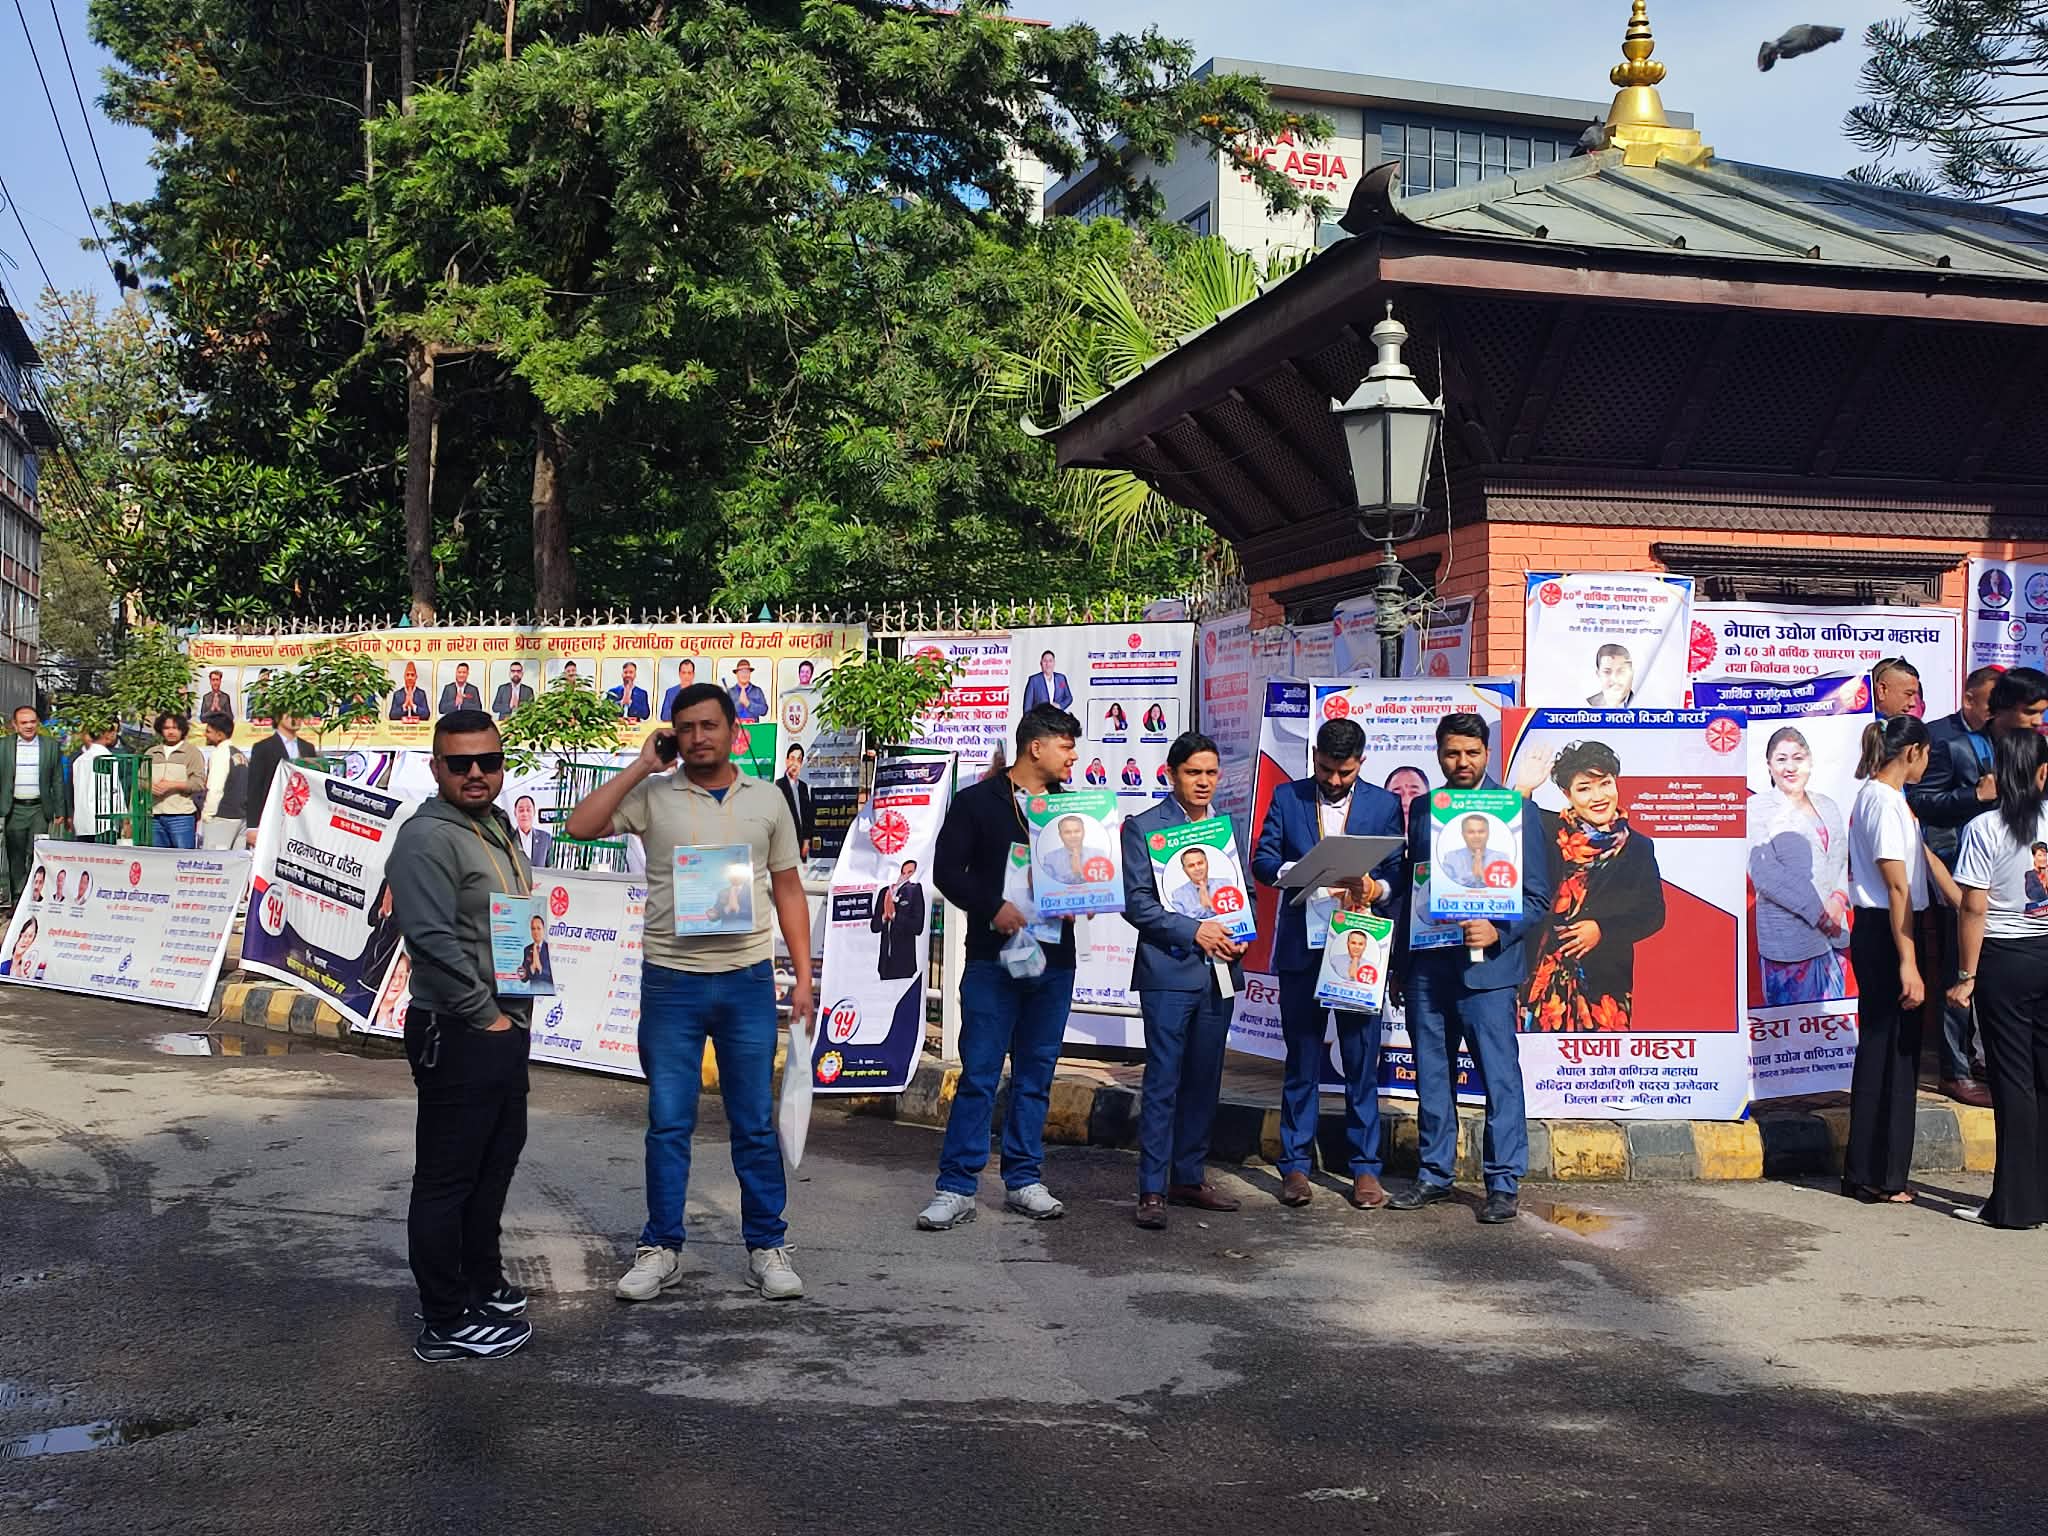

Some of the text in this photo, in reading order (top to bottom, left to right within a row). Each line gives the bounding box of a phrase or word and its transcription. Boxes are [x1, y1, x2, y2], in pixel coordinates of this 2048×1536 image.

[1283, 150, 1348, 179] ASIA
[1723, 620, 1940, 644] नेपाल उद्योग वाणिज्य महासंघ
[230, 640, 274, 659] साधारण
[277, 640, 303, 659] सभा
[386, 639, 422, 655] २०८३
[426, 638, 442, 652] मा
[445, 635, 477, 653] नरेश
[483, 637, 509, 653] लाल
[547, 632, 607, 657] समूहलाई
[612, 631, 674, 651] अत्याधिक
[740, 630, 785, 650] विजयी
[949, 643, 1009, 656] नेपाल उद्योग
[1725, 643, 1741, 657] को
[1744, 646, 1759, 657] ६०
[1779, 646, 1809, 659] वार्षिक
[1813, 648, 1855, 660] साधारण
[1858, 649, 1882, 660] सभा
[1725, 662, 1819, 676] तथा निर्वाचन २०८३
[1375, 702, 1407, 714] वार्षिक
[1411, 703, 1452, 715] साधारण
[1605, 710, 1635, 724] मतले
[1638, 711, 1675, 724] विजयी
[1087, 867, 1110, 881] १६
[1489, 873, 1512, 888] १६
[1217, 897, 1240, 913] १६
[1463, 898, 1485, 911] राज
[266, 895, 285, 930] १५
[584, 926, 617, 942] महासंघ
[834, 1010, 856, 1038] १५
[1557, 1038, 1697, 1064] सुष्मा महरा
[1774, 1046, 1844, 1064] उद्योग वाणिज्य
[1556, 1064, 1698, 1077] नेपाल उद्योग वाणिज्य महासंघ
[1575, 1079, 1635, 1091] कार्यकारिणी
[1638, 1080, 1669, 1091] सदस्य
[1672, 1079, 1720, 1092] उम्मेदवार
[1564, 1093, 1597, 1105] जिल्ला
[1629, 1093, 1664, 1105] महिला
[1666, 1093, 1692, 1105] कोटा
